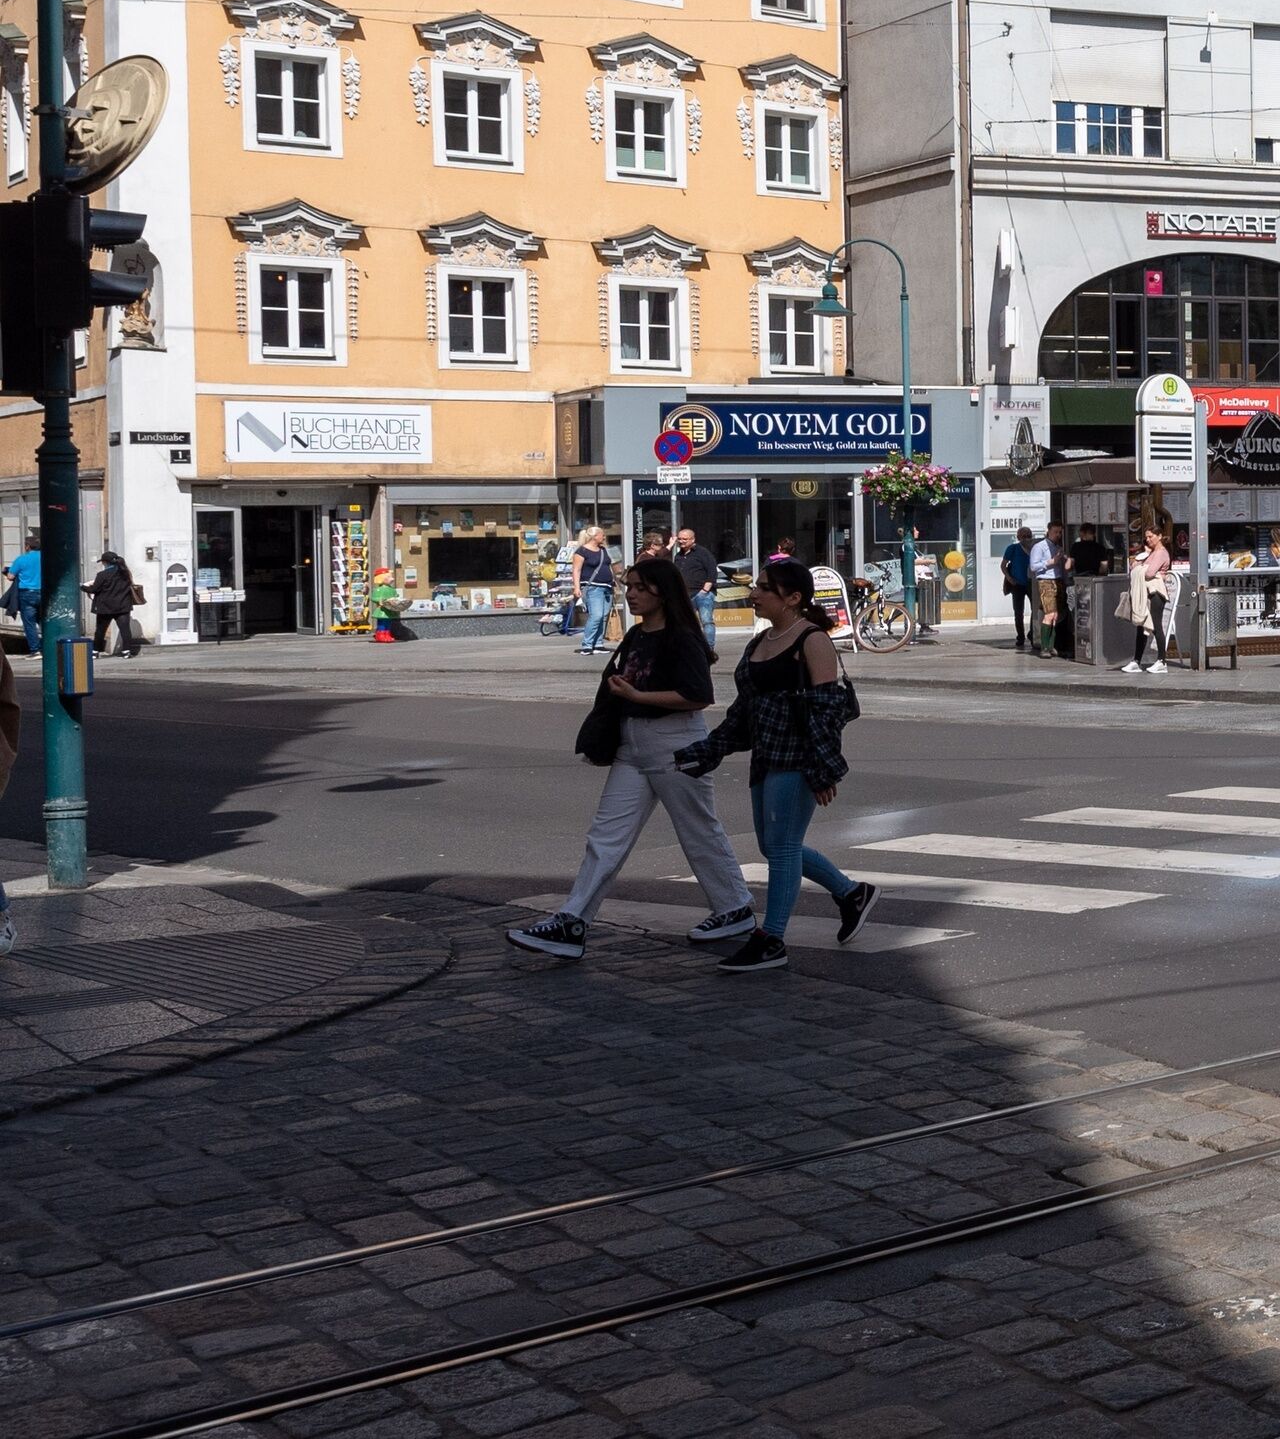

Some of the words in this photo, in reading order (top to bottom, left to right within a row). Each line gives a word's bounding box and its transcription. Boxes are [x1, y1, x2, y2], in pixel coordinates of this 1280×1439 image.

[1164, 212, 1276, 233] NOTARE
[1000, 401, 1041, 409] NOTARE
[1219, 397, 1270, 408] McDelivery
[291, 417, 421, 435] BUCHHANDEL
[729, 413, 833, 437] NOVEM
[846, 413, 926, 437] GOLD
[137, 432, 184, 443] Landstraße
[291, 434, 421, 451] NEUGEBAUER
[757, 440, 772, 450] Ein
[774, 440, 812, 450] besserer
[812, 440, 835, 452] Weg,
[836, 441, 856, 450] Gold
[857, 442, 867, 450] zu
[869, 441, 901, 450] kaufen.
[638, 488, 689, 496] Goldanauf
[695, 487, 746, 495] Edelmetalle
[992, 518, 1022, 529] EDINGER
